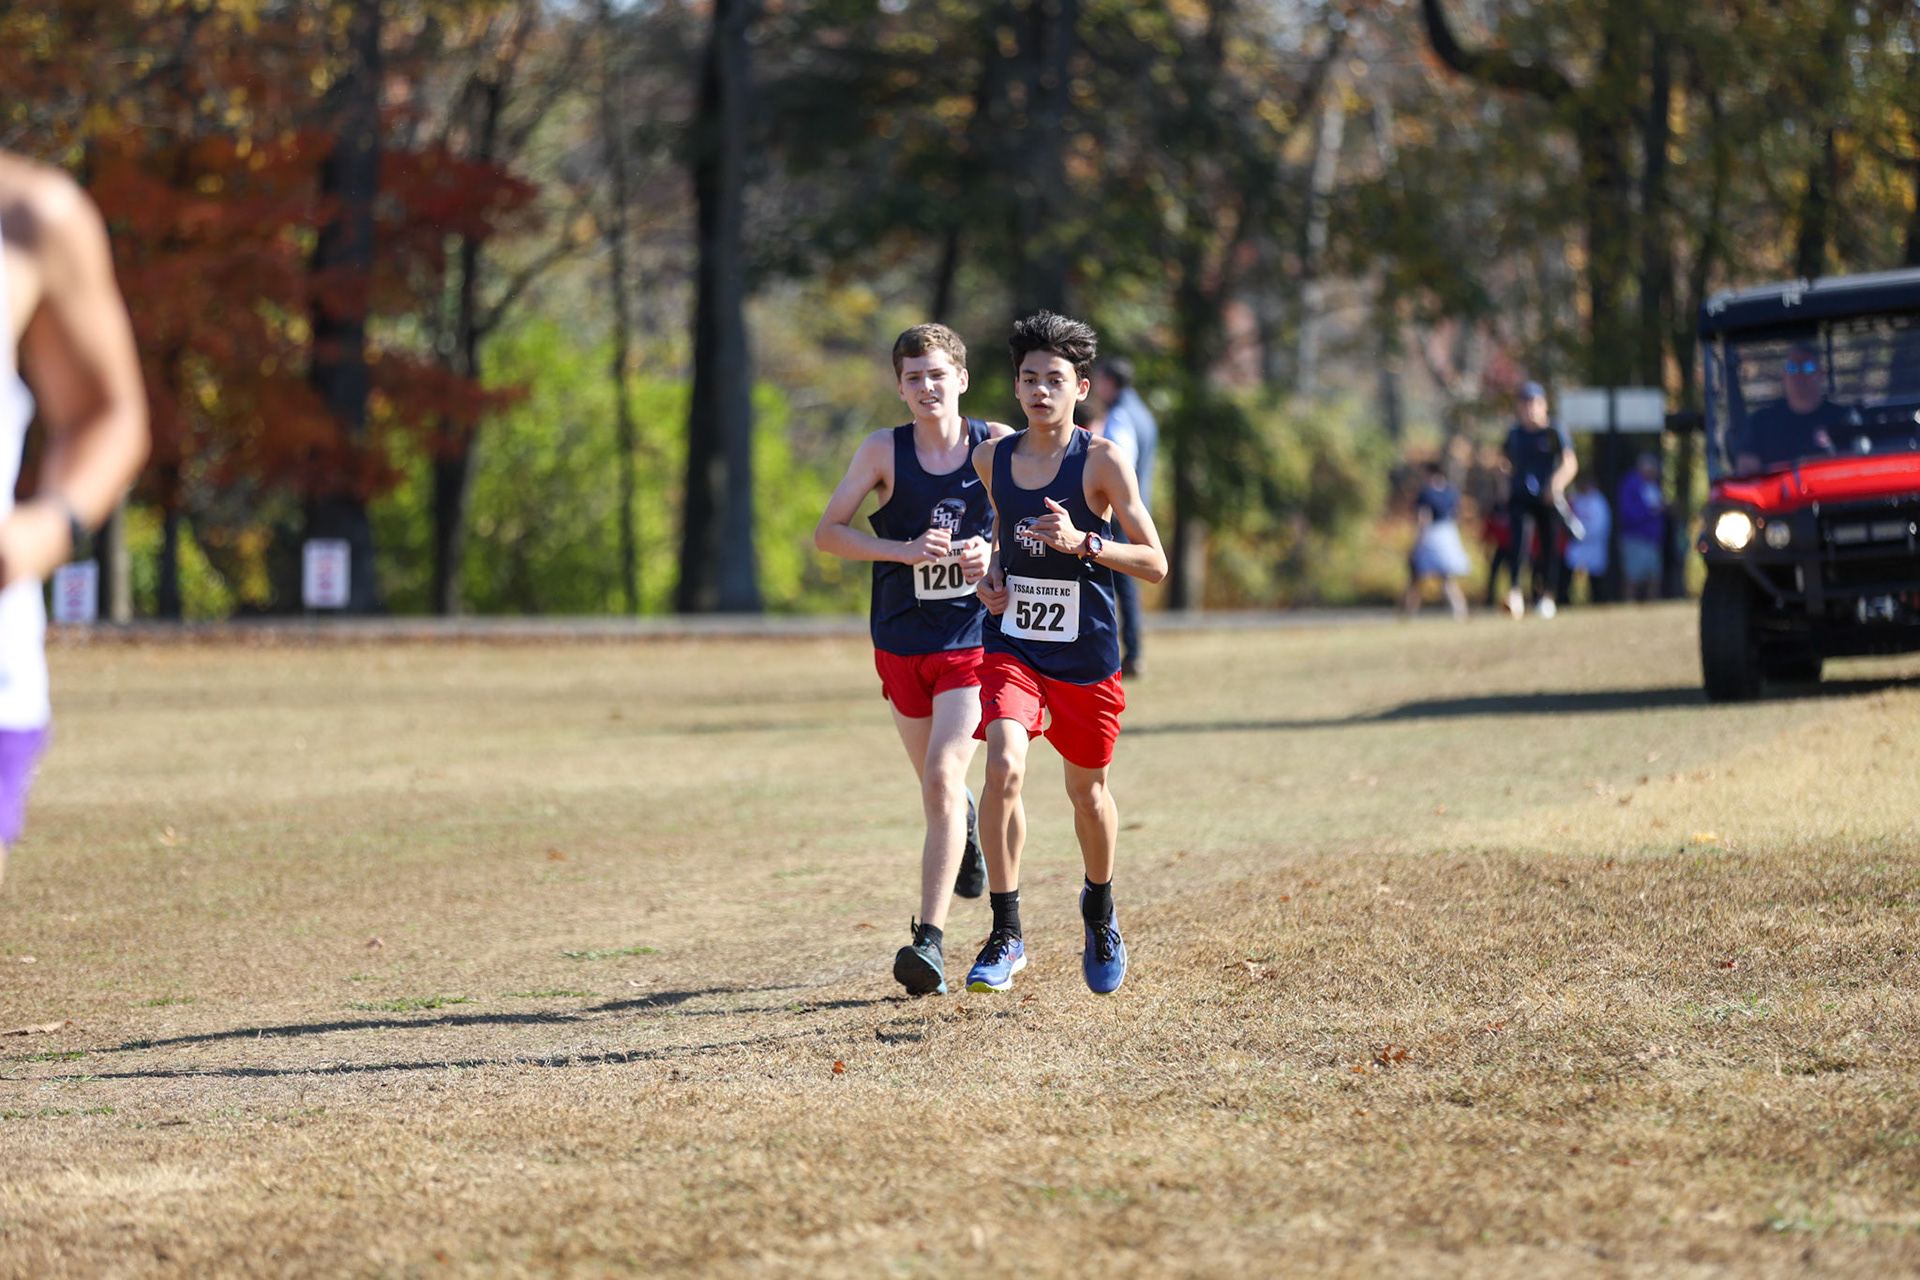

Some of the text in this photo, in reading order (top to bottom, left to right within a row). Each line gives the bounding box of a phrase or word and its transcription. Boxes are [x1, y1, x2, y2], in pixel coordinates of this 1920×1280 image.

[933, 507, 959, 532] SBA
[918, 563, 976, 591] 120
[1013, 583, 1071, 597] TSSAA STATE XC
[1015, 600, 1066, 632] 522
